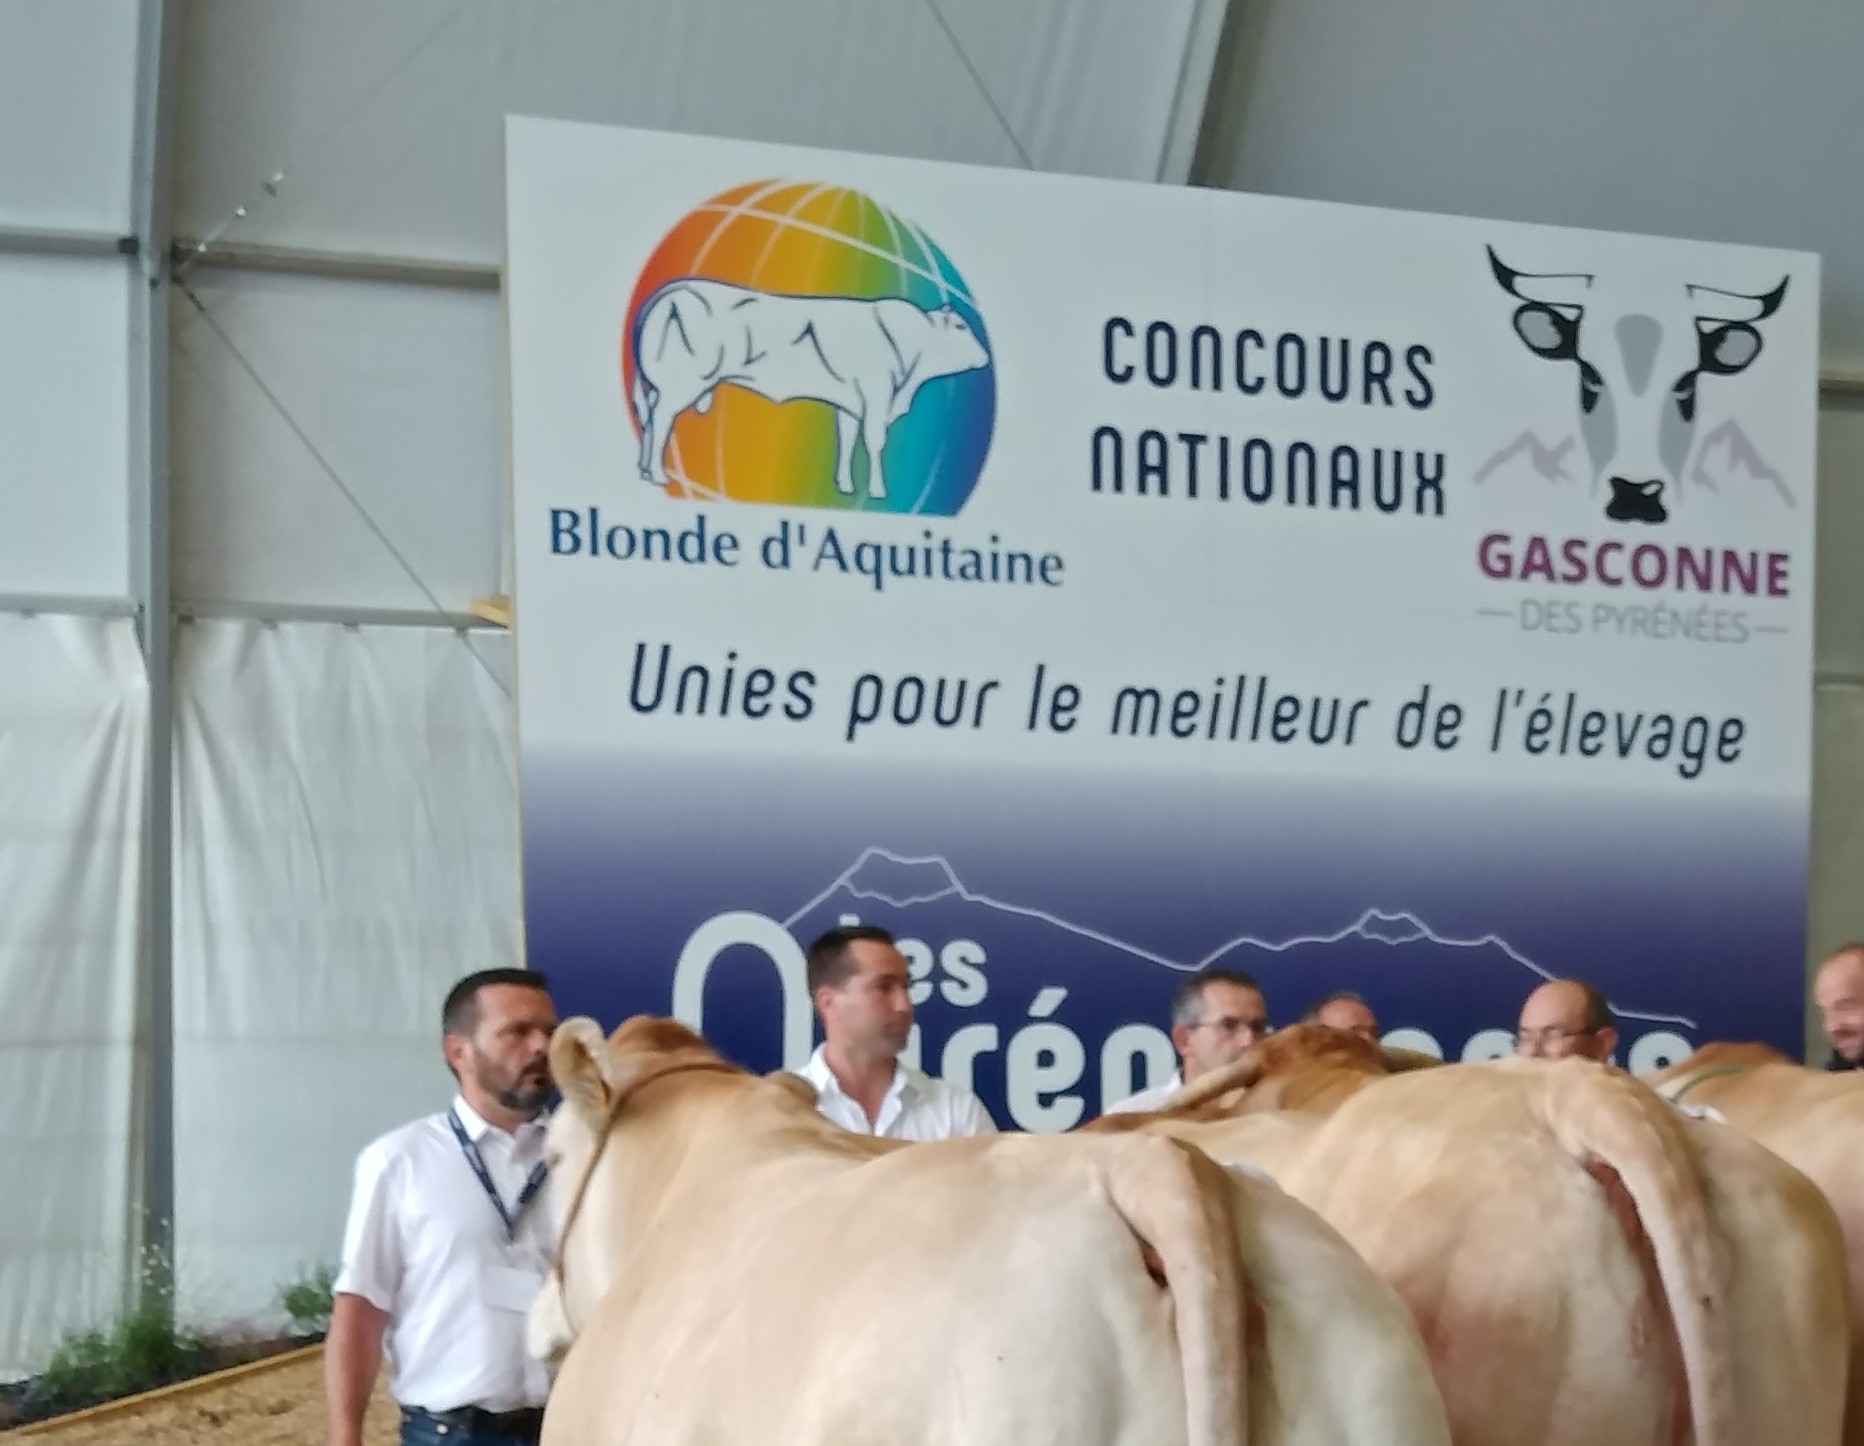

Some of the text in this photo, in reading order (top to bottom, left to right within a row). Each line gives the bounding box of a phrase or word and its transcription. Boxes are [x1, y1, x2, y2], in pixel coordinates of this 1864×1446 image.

[1103, 316, 1434, 410] CONCOURS
[1091, 425, 1445, 517] NATIONAUX
[549, 507, 1064, 592] Blonde d'Aquitaine
[1478, 533, 1790, 598] GASCONNE
[1520, 598, 1749, 645] DES PYRÉNÉES
[629, 642, 1745, 780] Unies pour le meilleur de l'élevage
